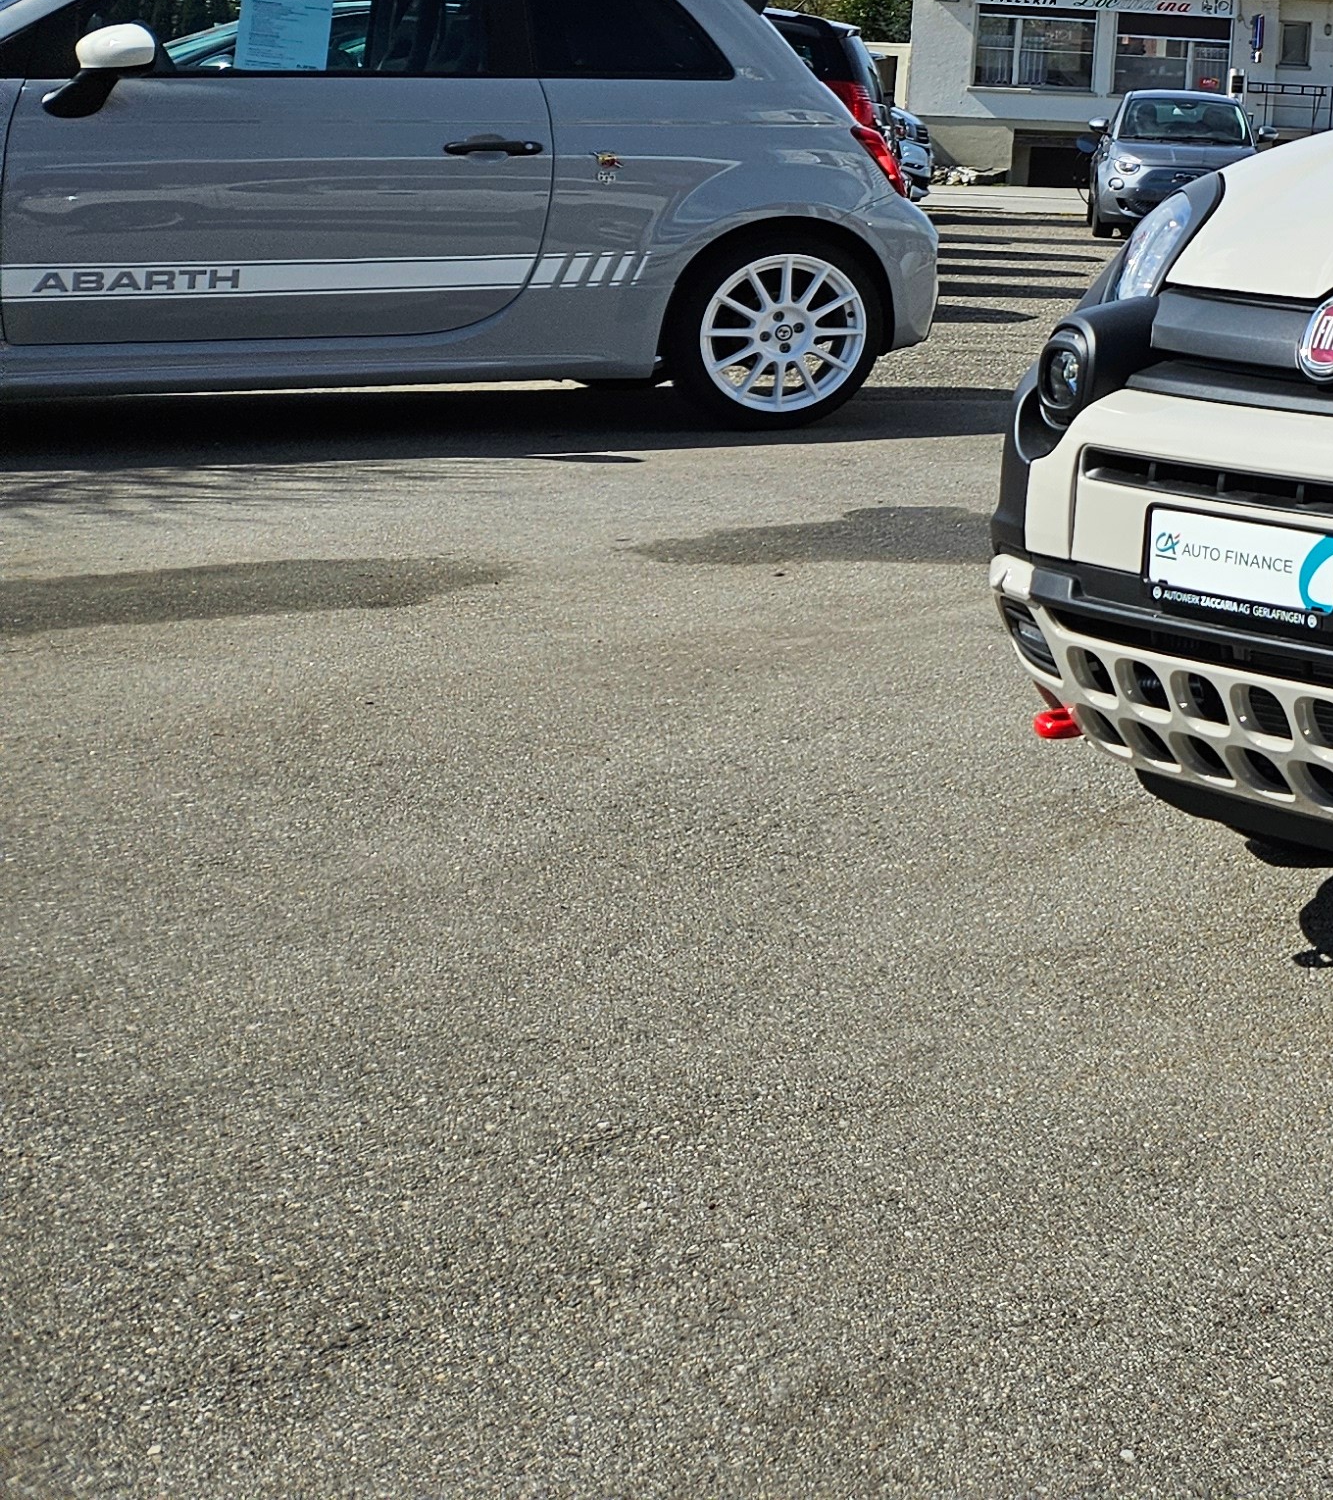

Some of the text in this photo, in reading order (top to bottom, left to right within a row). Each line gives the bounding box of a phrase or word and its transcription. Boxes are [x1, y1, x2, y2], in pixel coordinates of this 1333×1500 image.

[32, 269, 240, 293] ABARTH
[1182, 543, 1221, 562] AUTO
[1225, 550, 1293, 574] FINANCE
[1162, 589, 1305, 625] AUTOWERK ZACCARIA AG GERLAFINGEN
